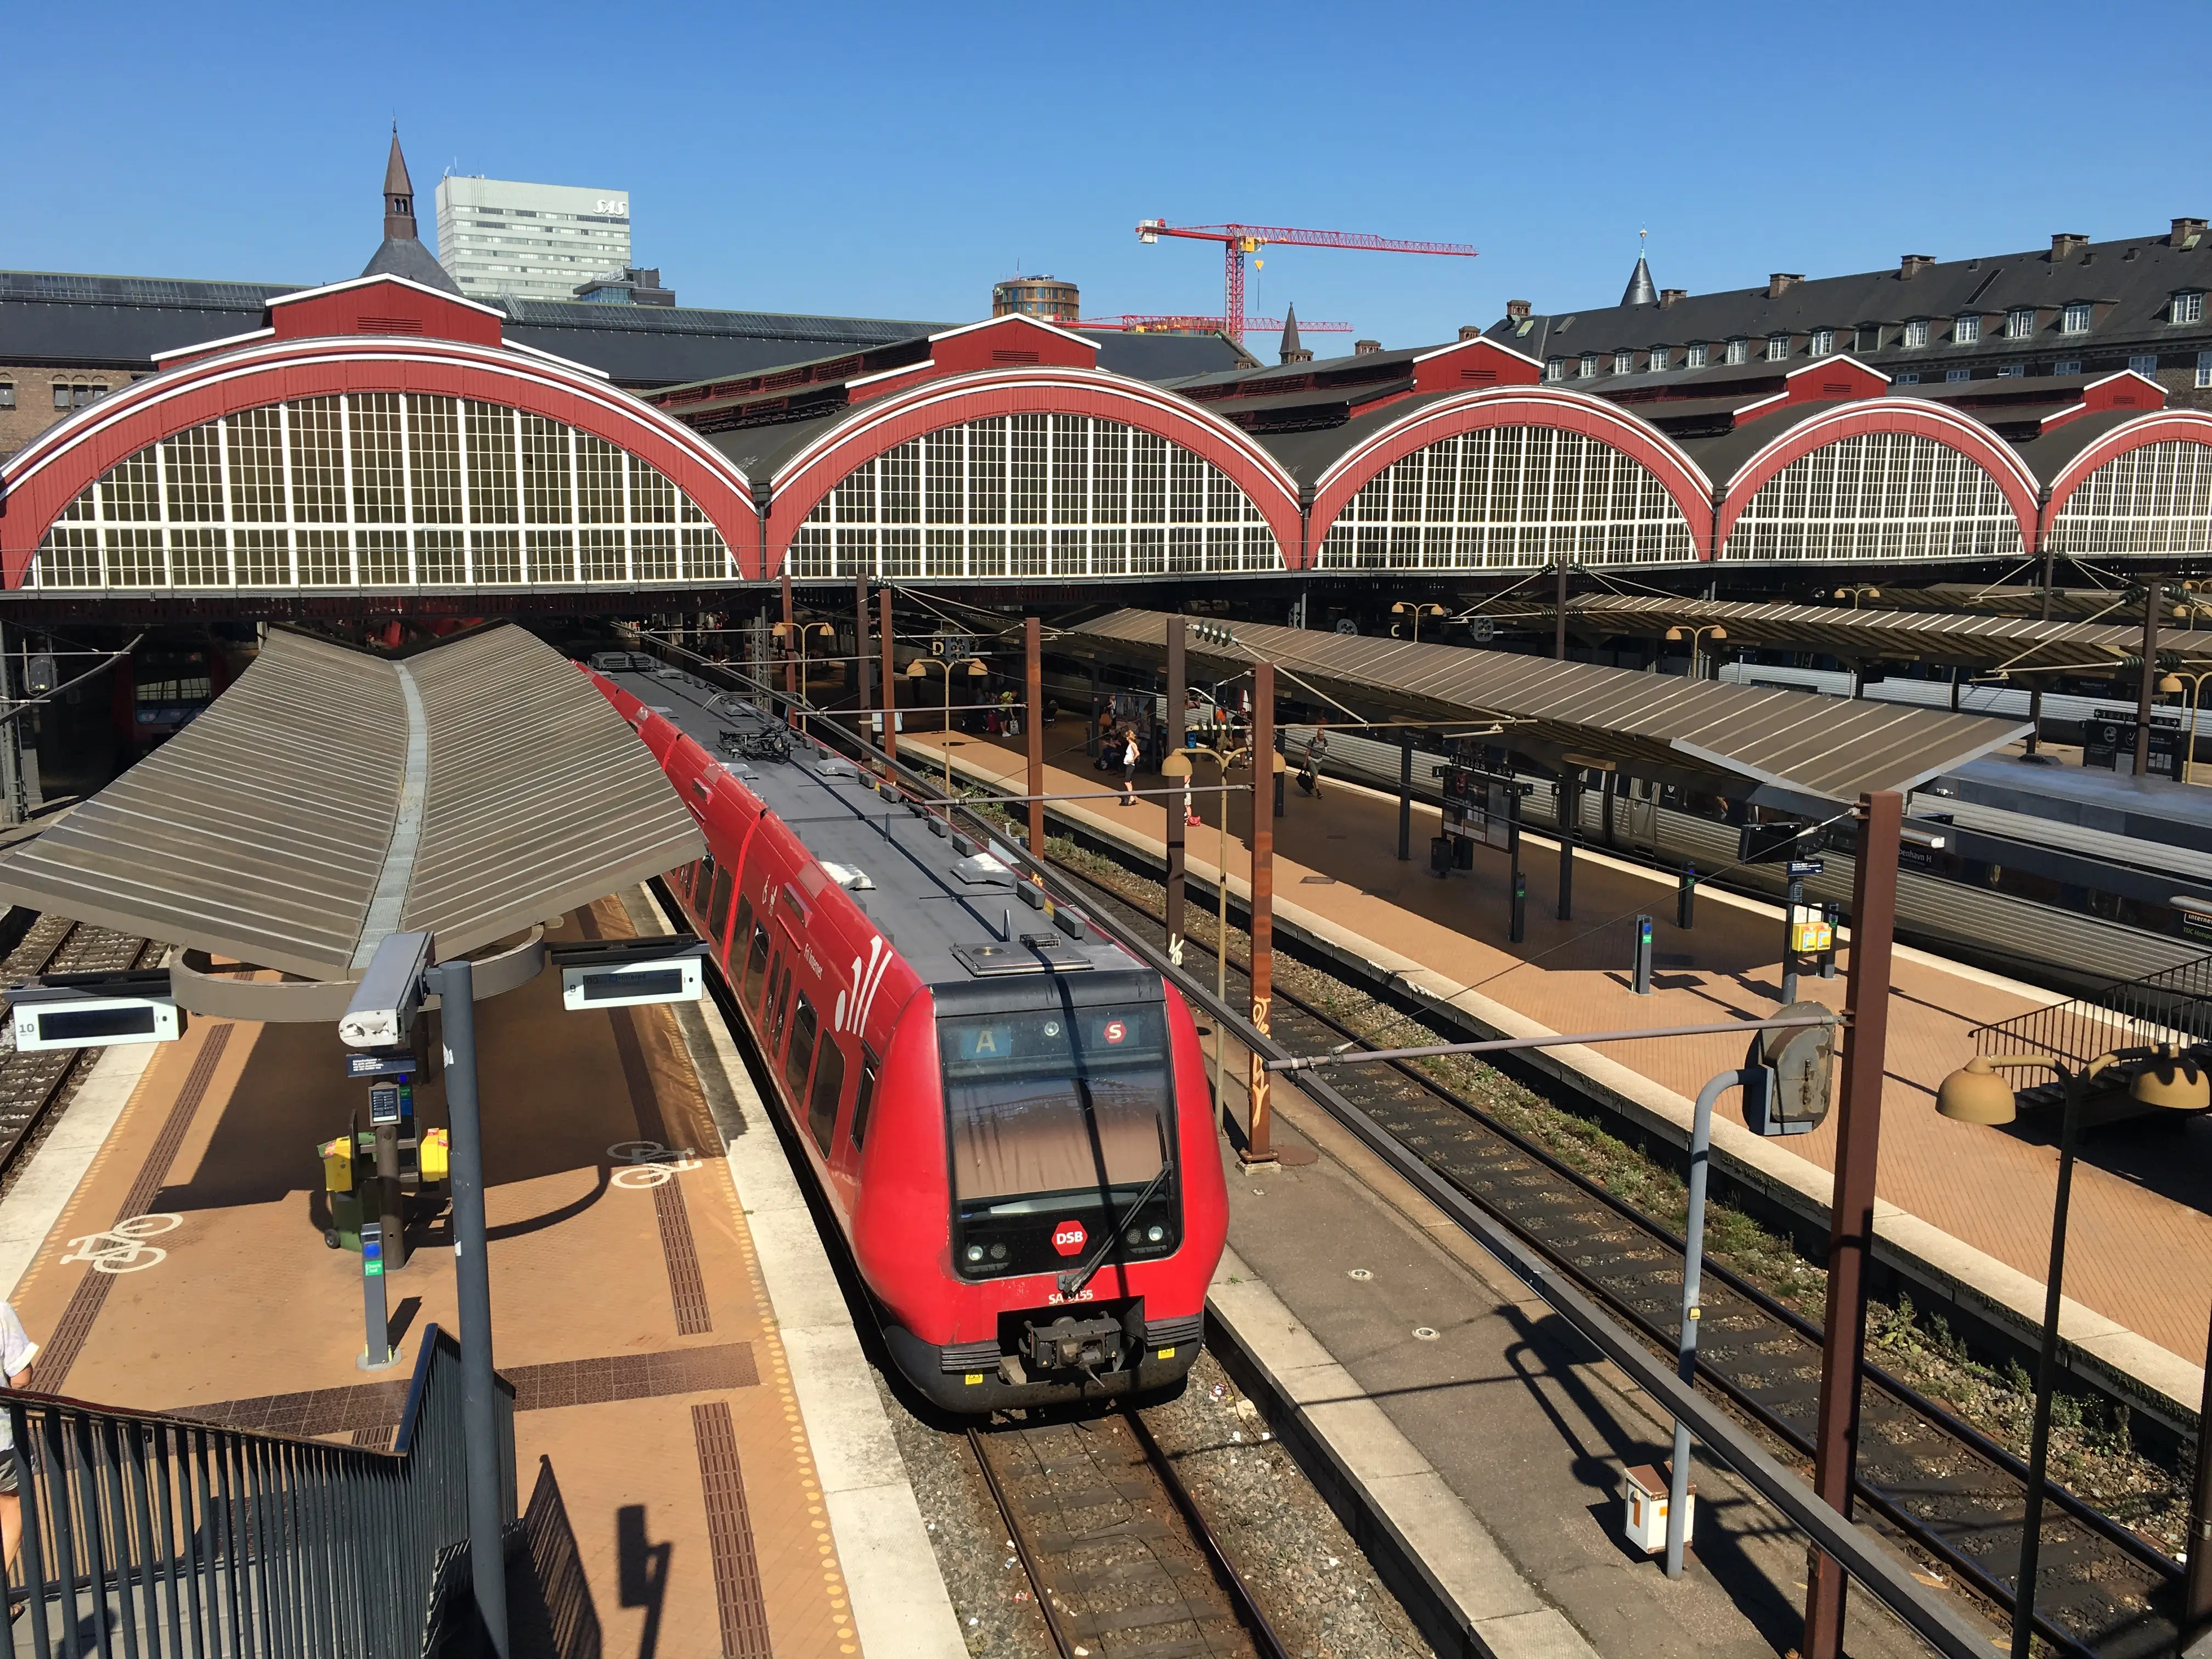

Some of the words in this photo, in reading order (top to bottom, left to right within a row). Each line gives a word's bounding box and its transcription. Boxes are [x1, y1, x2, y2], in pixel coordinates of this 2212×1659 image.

[592, 199, 627, 216] SAS
[1391, 624, 1400, 637] C
[933, 641, 944, 656] D
[1899, 847, 1925, 861] benhavn
[1926, 855, 1932, 863] H
[2183, 927, 2194, 935] TDC
[570, 984, 576, 993] 9
[19, 1023, 35, 1033] 10
[1108, 1024, 1121, 1039] S
[976, 1030, 996, 1053] A
[1056, 1231, 1084, 1245] DSB
[1048, 1293, 1064, 1305] SA
